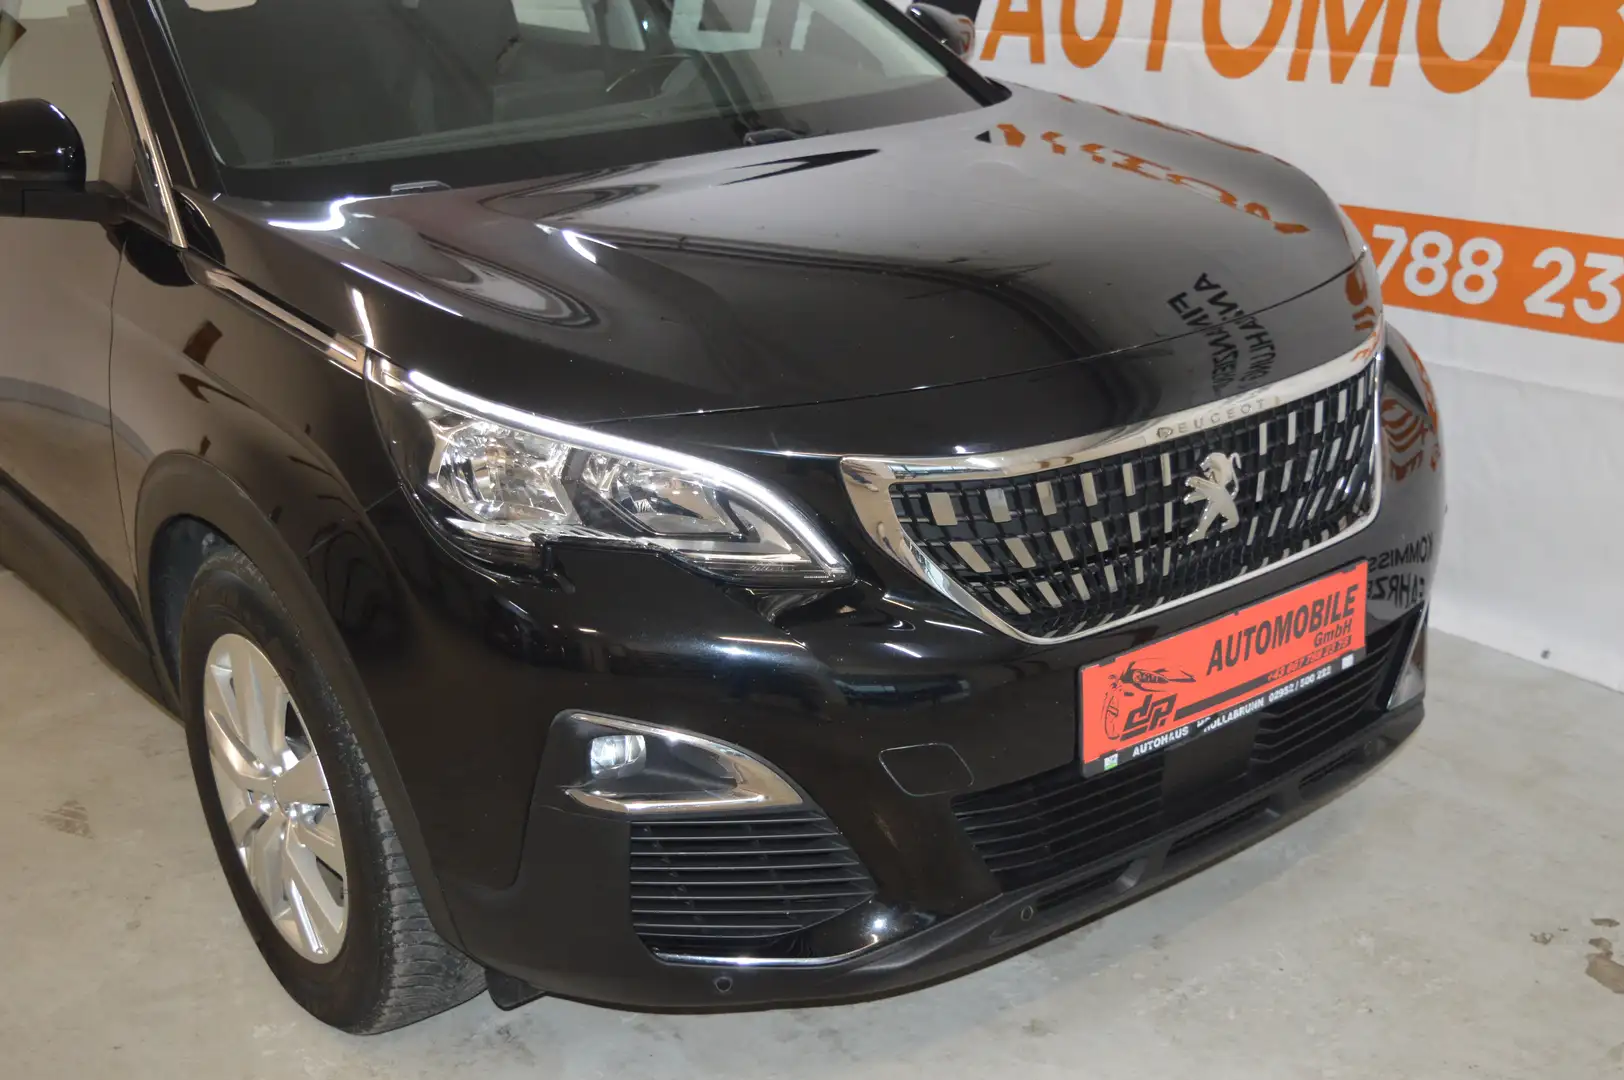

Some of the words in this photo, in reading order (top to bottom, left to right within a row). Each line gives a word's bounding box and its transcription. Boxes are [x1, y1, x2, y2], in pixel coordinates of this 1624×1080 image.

[1372, 223, 1504, 305] 788
[1523, 246, 1624, 325] 23
[1156, 399, 1265, 439] PEUGEOT
[1206, 584, 1359, 676] AUTOMOBILE
[1314, 620, 1353, 648] GmbH
[1132, 726, 1189, 757] AUTOHAUS
